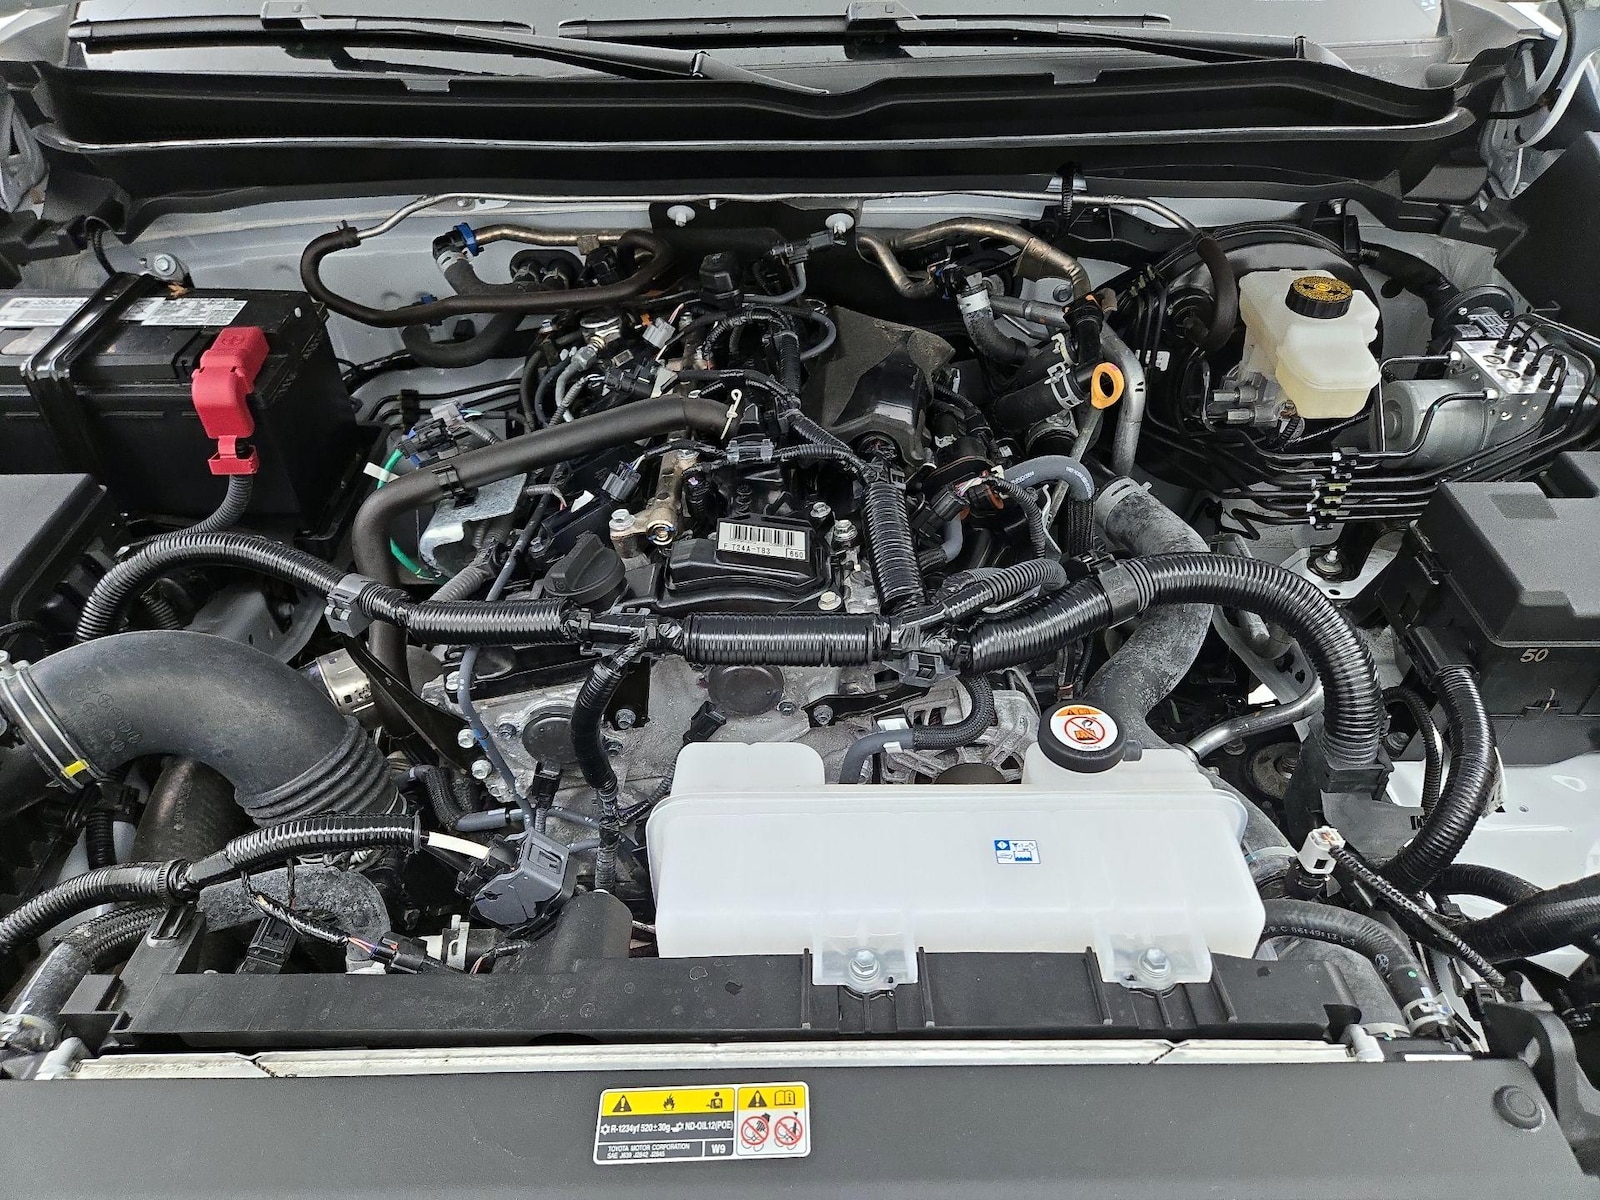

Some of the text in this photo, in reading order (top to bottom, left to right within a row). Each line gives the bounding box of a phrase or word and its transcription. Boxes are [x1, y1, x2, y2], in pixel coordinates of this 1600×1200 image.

[1520, 648, 1549, 662] 50
[610, 1124, 640, 1134] R-1234yf
[711, 1143, 726, 1154] W9
